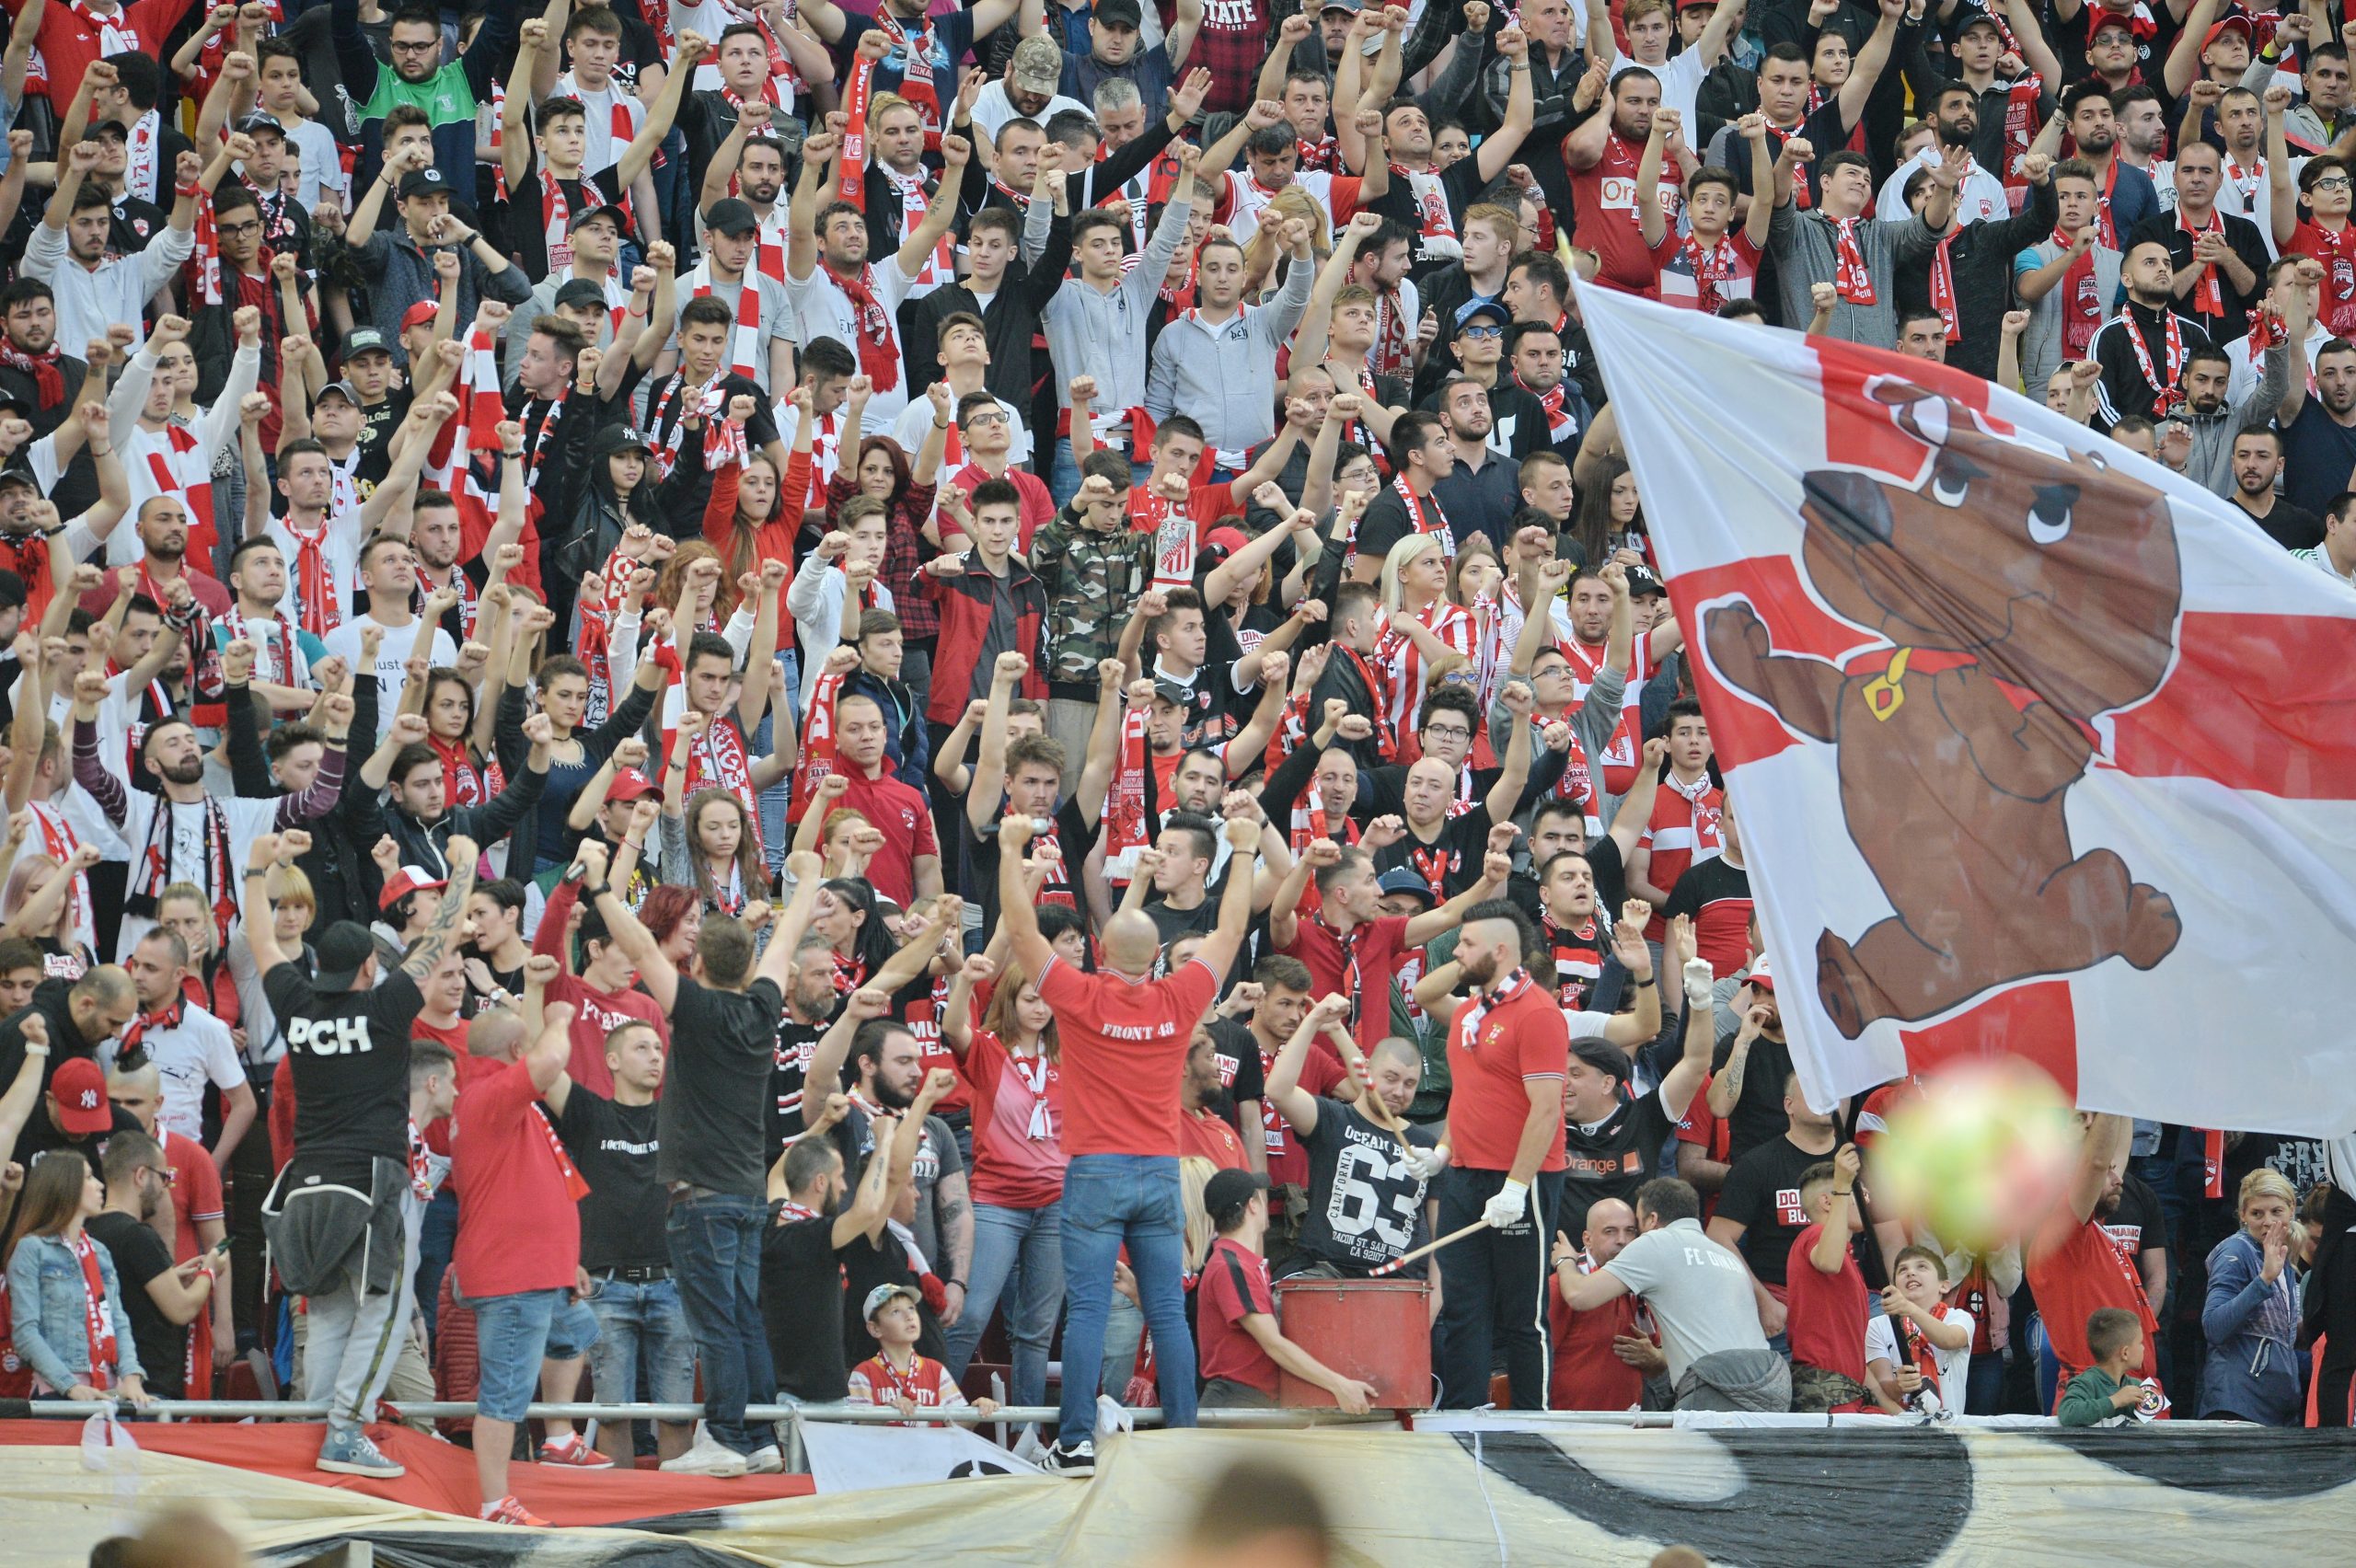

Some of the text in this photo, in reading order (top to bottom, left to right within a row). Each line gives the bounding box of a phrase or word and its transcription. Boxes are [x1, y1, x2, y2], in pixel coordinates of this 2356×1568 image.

[1205, 20, 1221, 29] NEW
[1160, 539, 1187, 566] DINAMO
[1634, 565, 1654, 581] NY
[287, 1015, 373, 1055] PCH
[1101, 1022, 1175, 1041] FRONT 48
[1344, 1124, 1390, 1151] OCEAN
[1330, 1151, 1353, 1218] CALIFORNIA
[1332, 1230, 1356, 1244] BACON
[1356, 1237, 1369, 1249] ST.
[1369, 1241, 1387, 1253] SAN
[1350, 1246, 1387, 1263] CA 92107
[1683, 1247, 1704, 1266] FC
